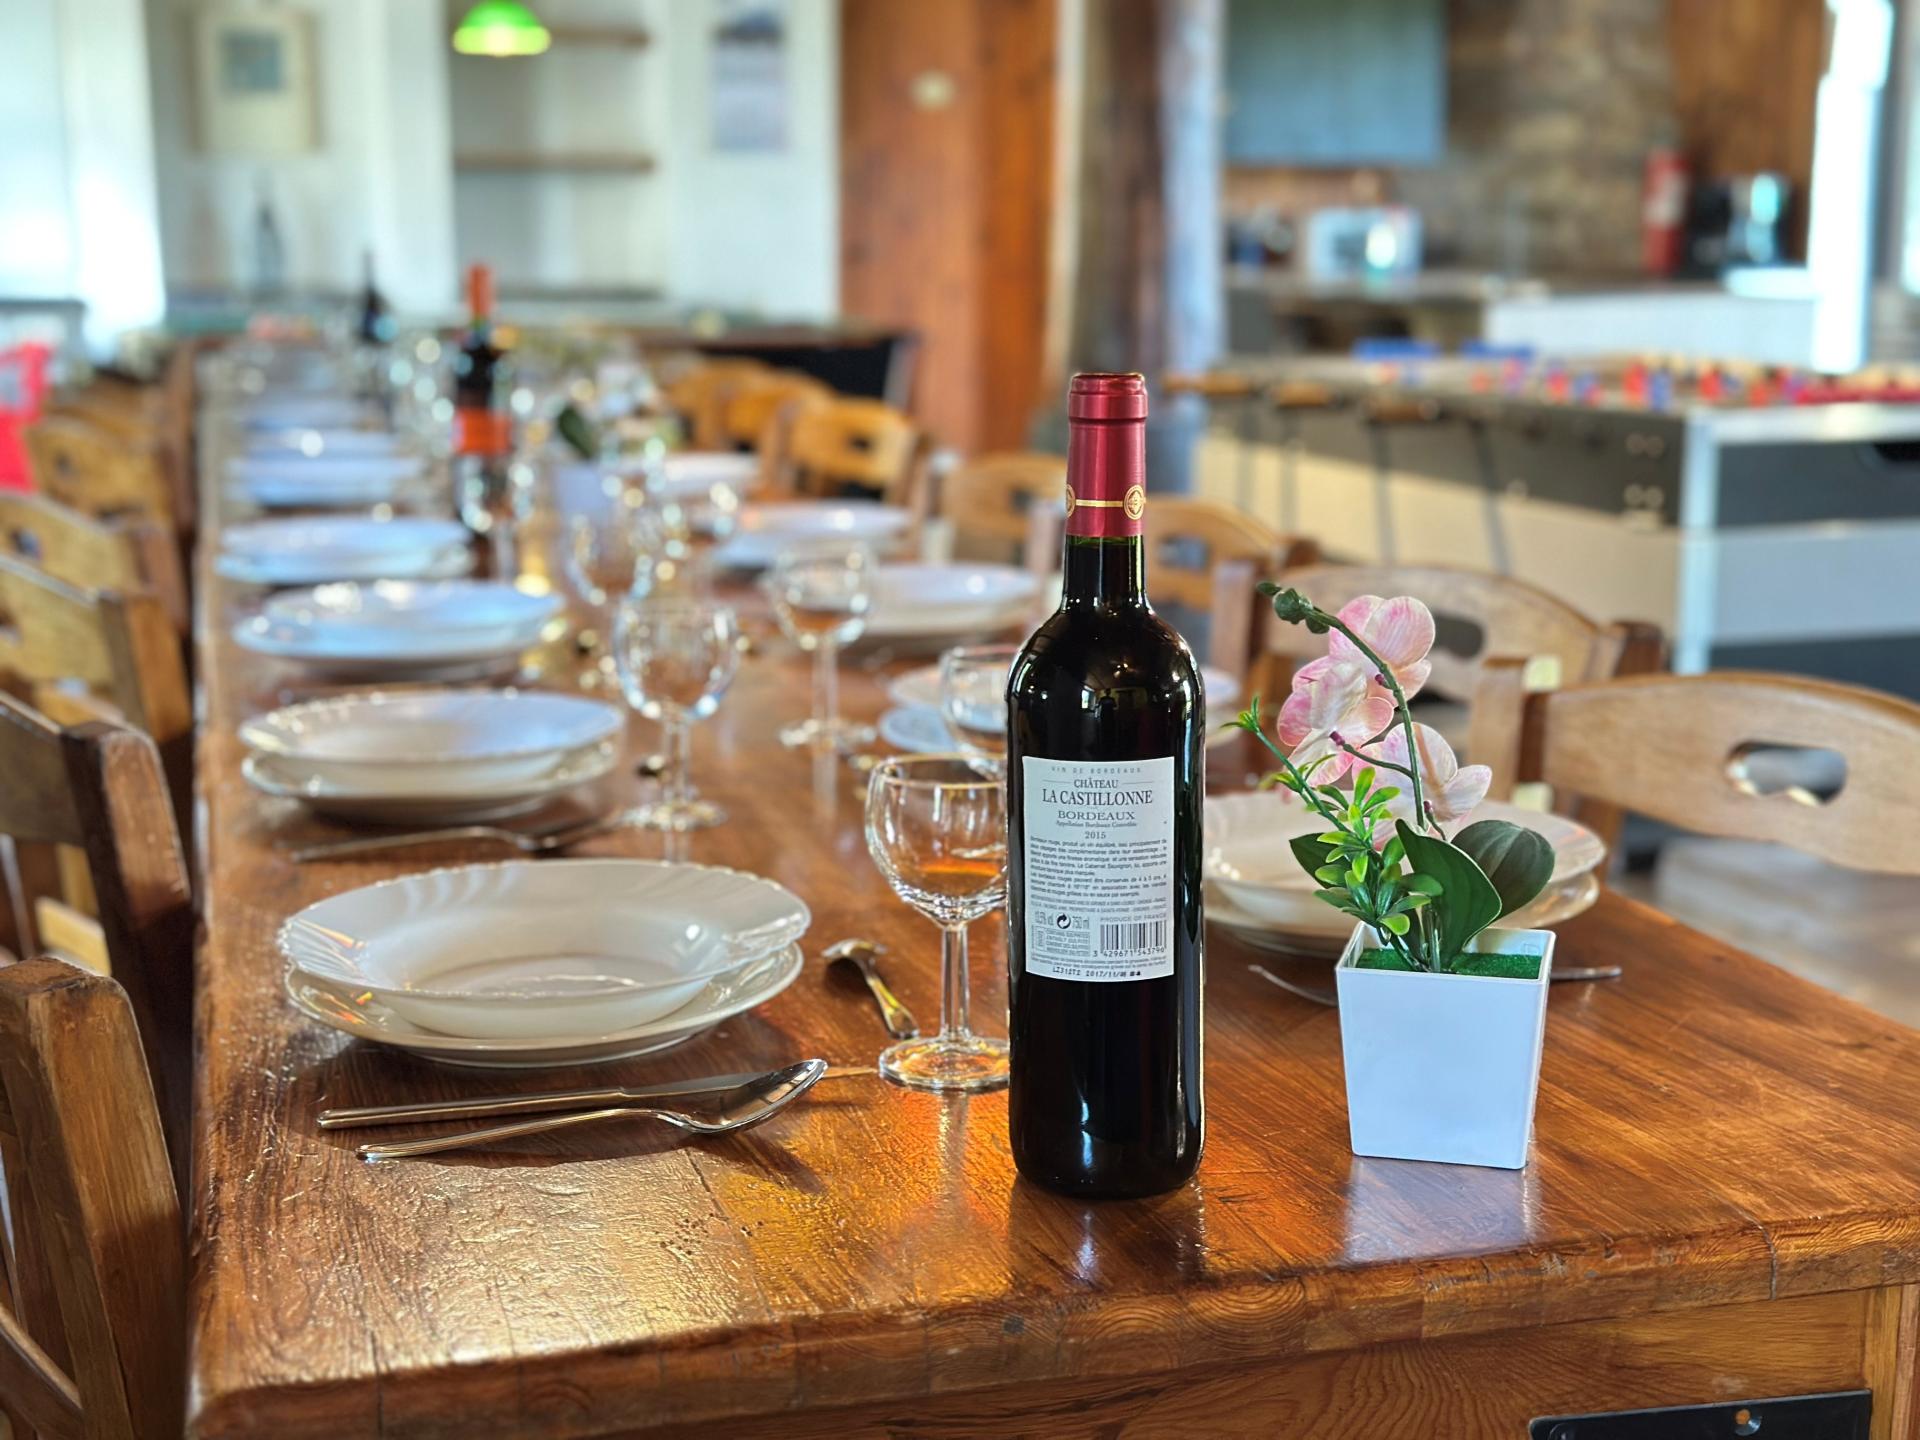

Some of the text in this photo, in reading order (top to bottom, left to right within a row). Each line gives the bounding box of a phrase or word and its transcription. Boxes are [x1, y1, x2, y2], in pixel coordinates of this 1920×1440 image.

[1074, 777, 1119, 788] CHÂTEAU
[1042, 788, 1153, 805] LA CASTILLONNE
[1058, 810, 1135, 821] BORDEAUX
[1085, 831, 1106, 839] 2015
